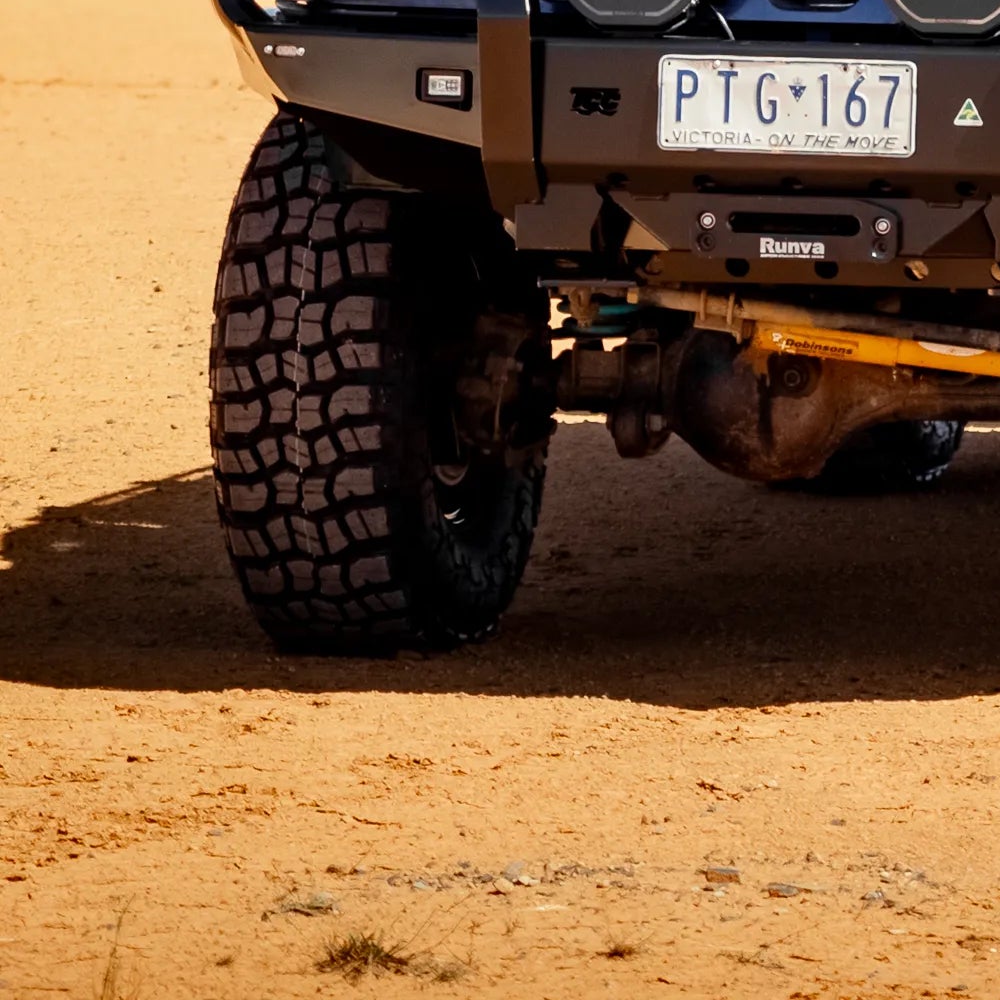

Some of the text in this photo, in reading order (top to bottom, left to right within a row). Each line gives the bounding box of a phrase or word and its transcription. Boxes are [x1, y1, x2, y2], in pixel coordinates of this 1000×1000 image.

[672, 130, 752, 145] VICTORIA
[768, 133, 796, 148] ON
[803, 134, 841, 149] THE
[843, 135, 898, 150] MOVE
[759, 236, 826, 255] Runva
[784, 338, 853, 355] Dobinsons
